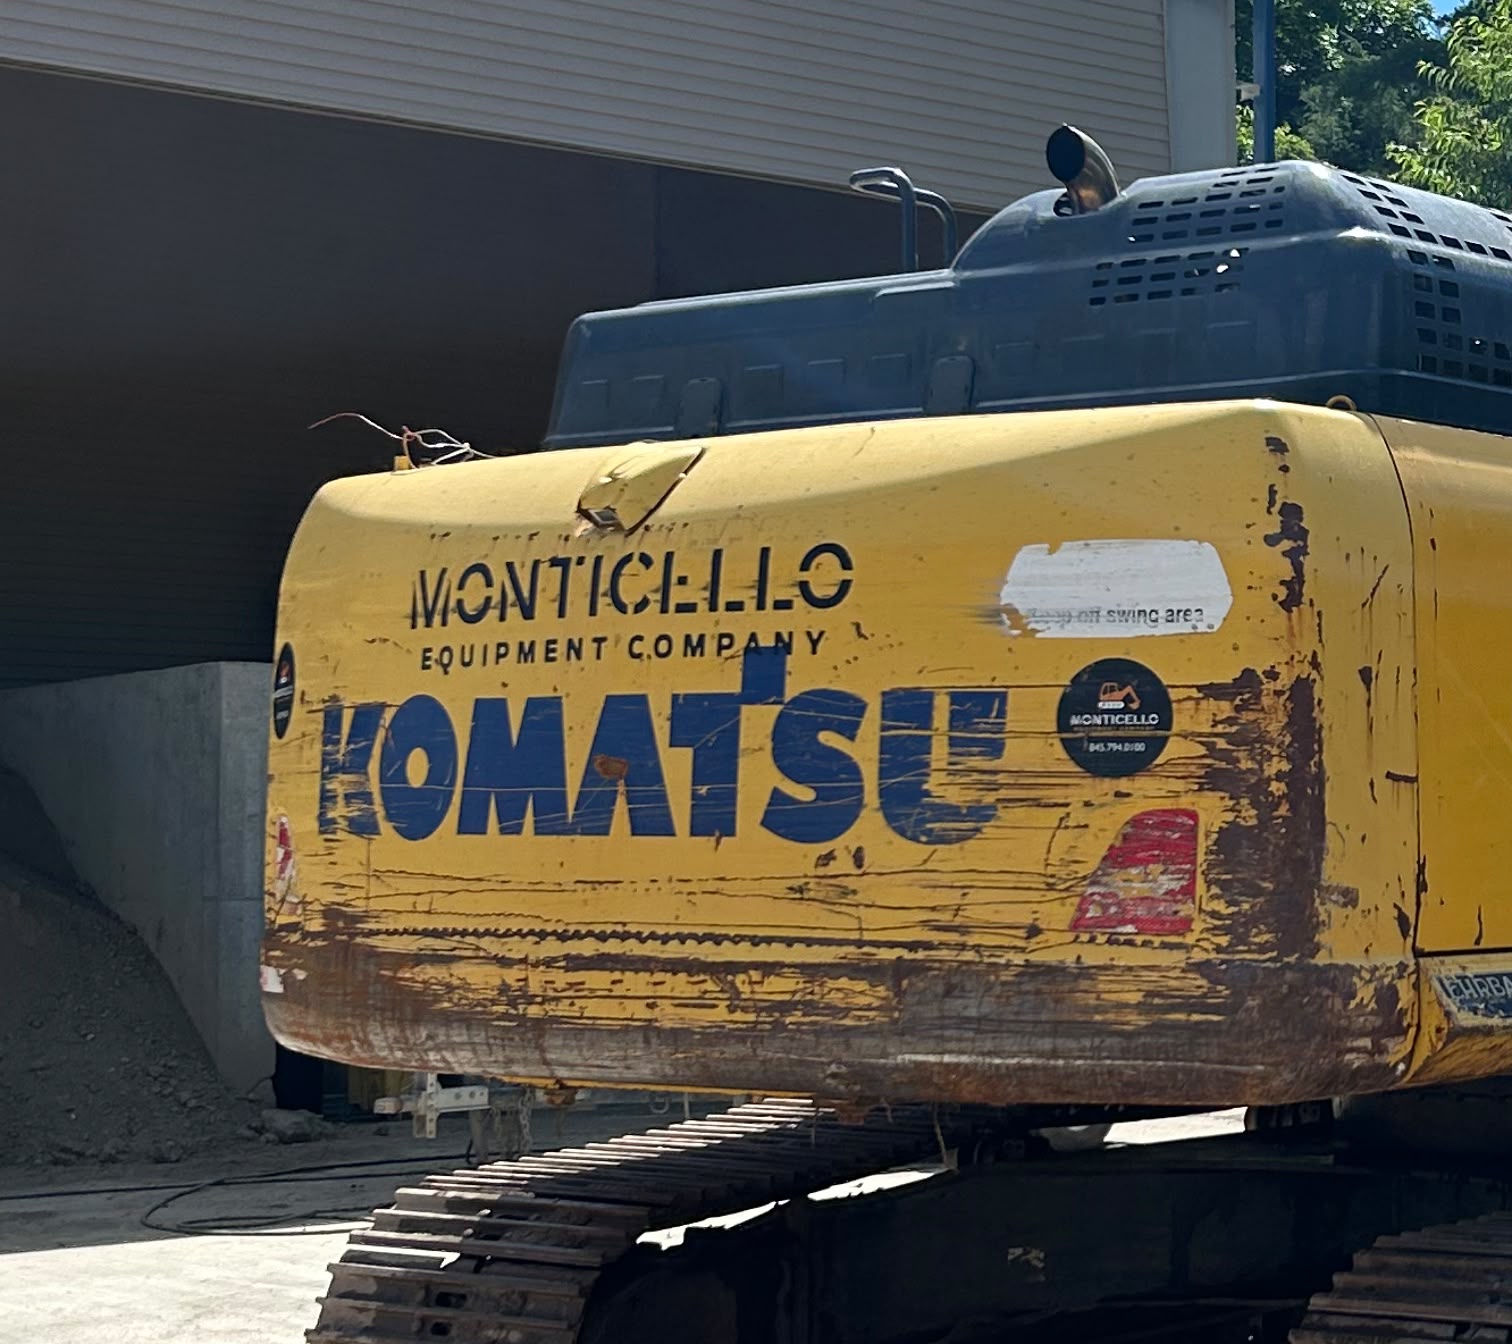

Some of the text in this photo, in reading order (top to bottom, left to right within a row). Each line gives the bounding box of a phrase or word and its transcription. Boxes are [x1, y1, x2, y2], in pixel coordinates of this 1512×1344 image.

[410, 542, 854, 630] MONTICELLO
[1106, 607, 1159, 628] swing
[1164, 607, 1204, 624] area
[420, 629, 826, 675] EQUIPMENT COMPANY
[1070, 713, 1160, 726] MONTICELLO
[317, 645, 1009, 845] KOMATSU
